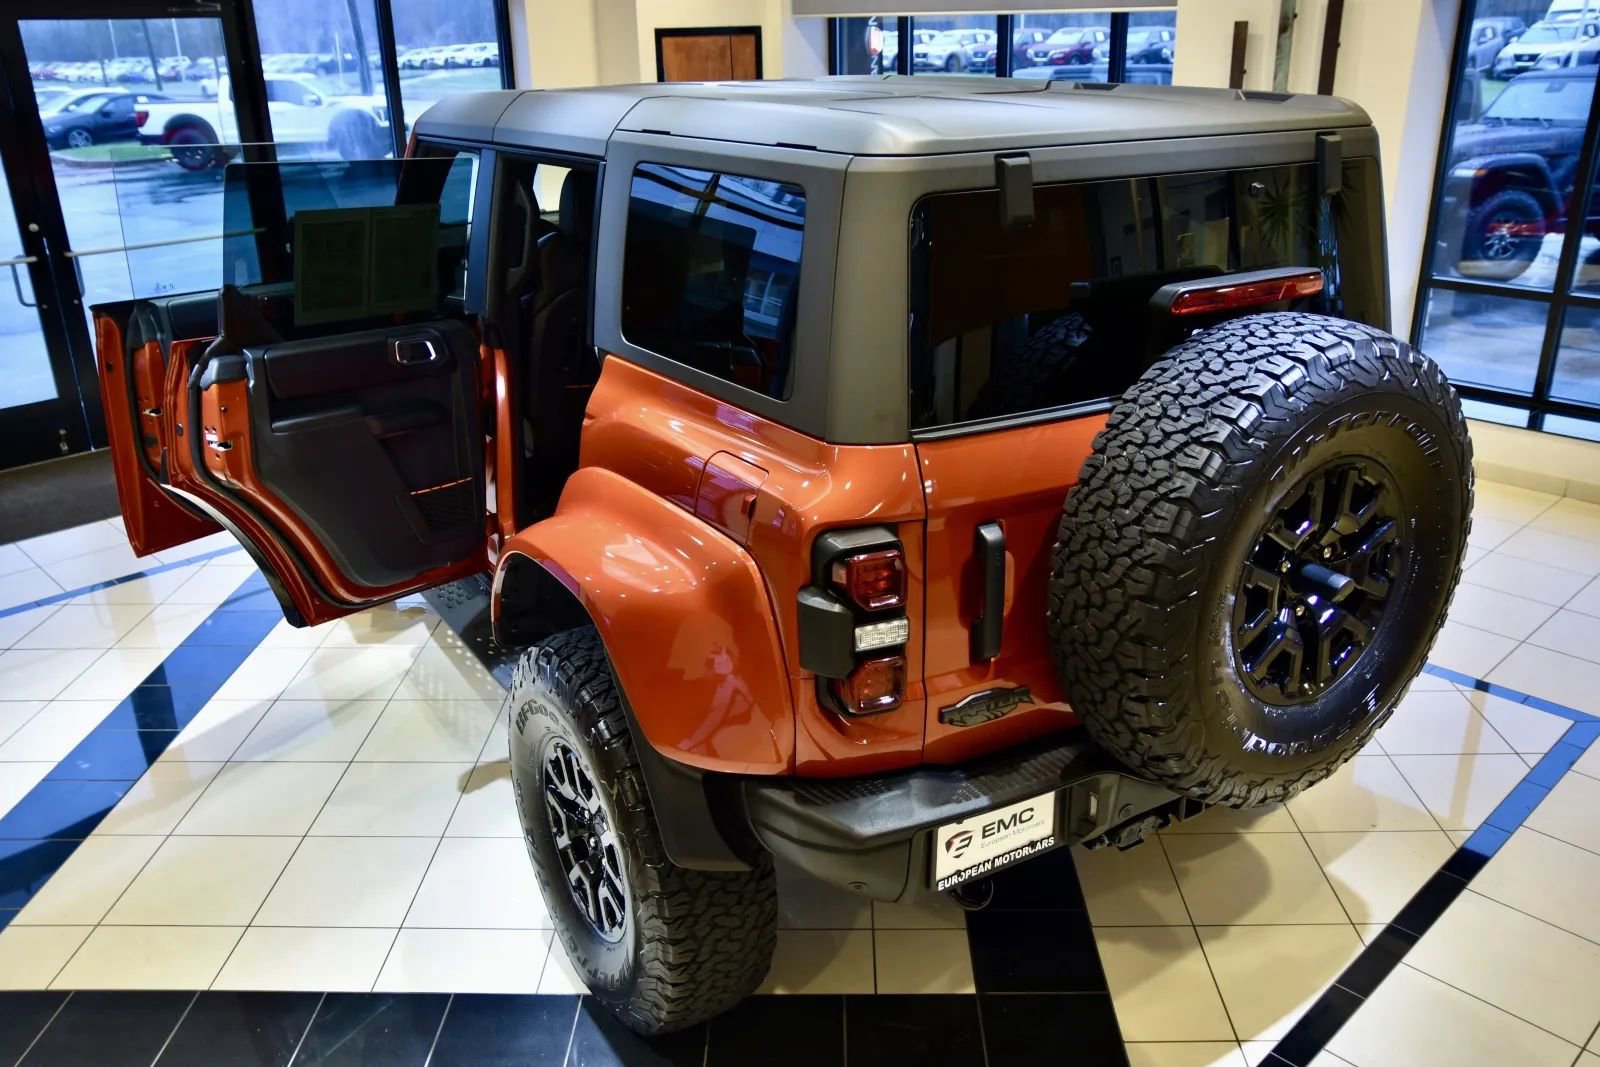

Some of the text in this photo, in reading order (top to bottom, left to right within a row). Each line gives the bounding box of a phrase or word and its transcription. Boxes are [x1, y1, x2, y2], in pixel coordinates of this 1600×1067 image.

[980, 819, 1045, 849] European Motorcars
[981, 807, 1035, 840] EMC
[937, 836, 1056, 892] EUROPEAN MOTORCARS
